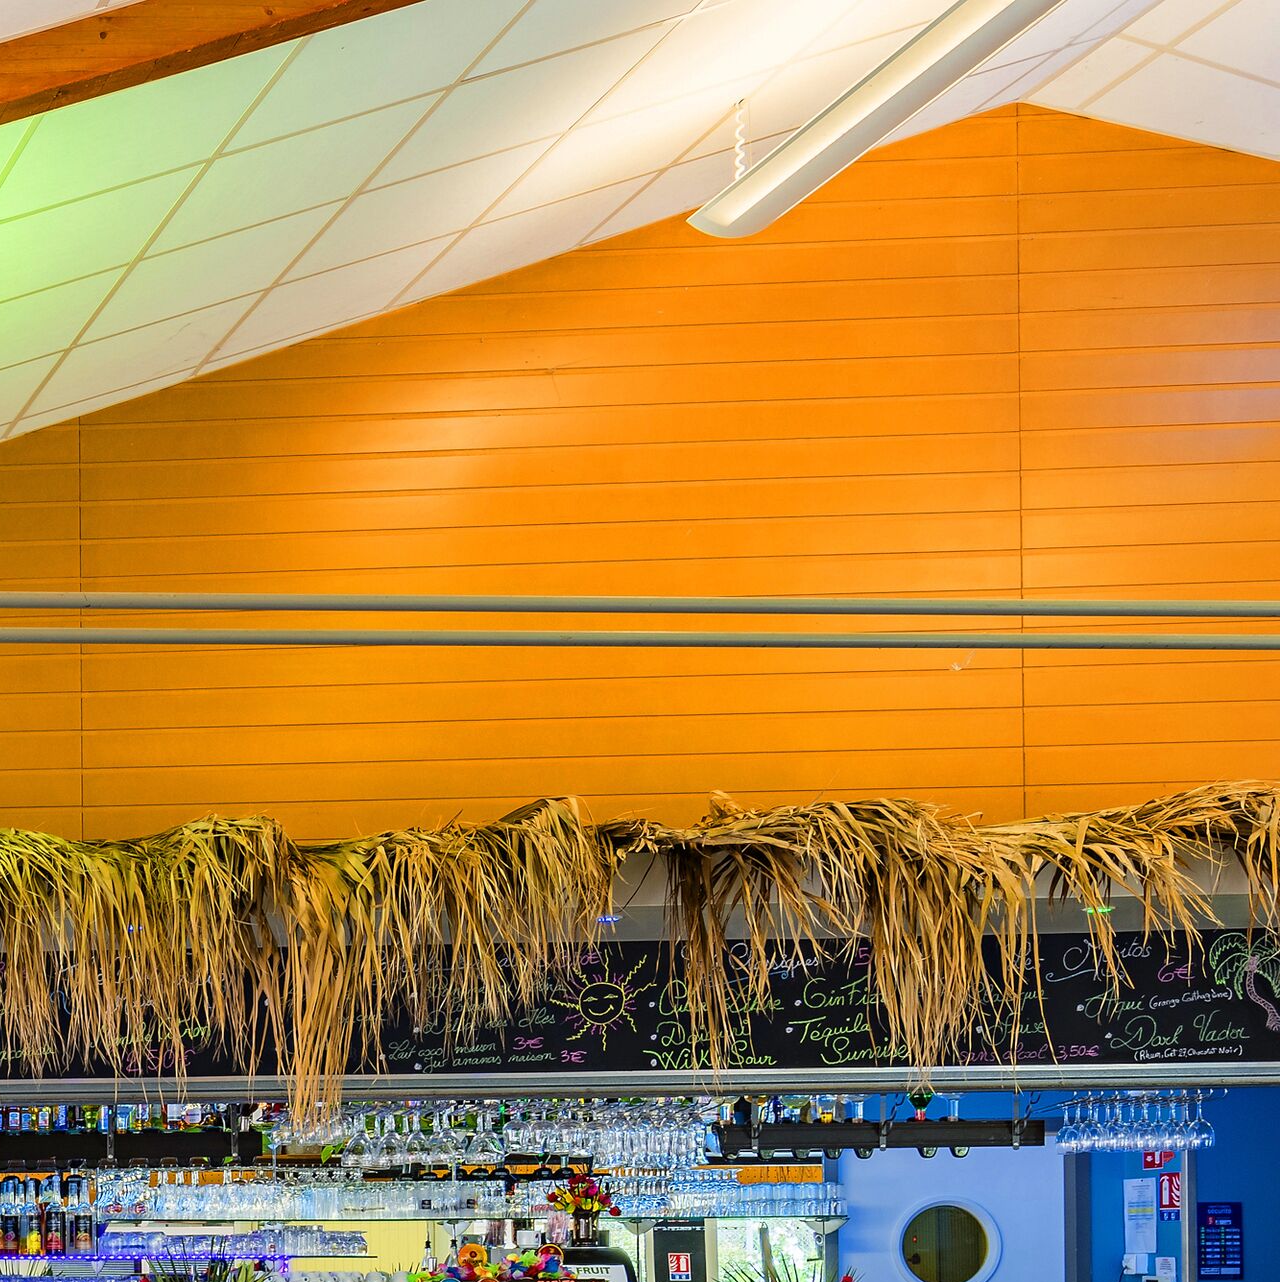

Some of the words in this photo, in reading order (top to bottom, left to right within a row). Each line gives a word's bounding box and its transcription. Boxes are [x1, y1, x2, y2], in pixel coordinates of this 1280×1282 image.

[1158, 962, 1195, 983] 6€
[1110, 1014, 1184, 1050] Dark
[1193, 1009, 1250, 1042] Vador
[389, 1040, 415, 1060] Lait
[418, 1046, 444, 1057] coco
[454, 1042, 496, 1054] maison
[513, 1037, 544, 1050] 3€
[728, 1040, 777, 1066] Sour
[960, 1051, 996, 1063] sans
[1056, 1045, 1100, 1060] 3,50€
[422, 1056, 446, 1073] Jus
[452, 1055, 502, 1067] ananas
[508, 1052, 557, 1063] maison
[560, 1050, 588, 1064] 3€
[576, 1266, 611, 1275] FRUIT
